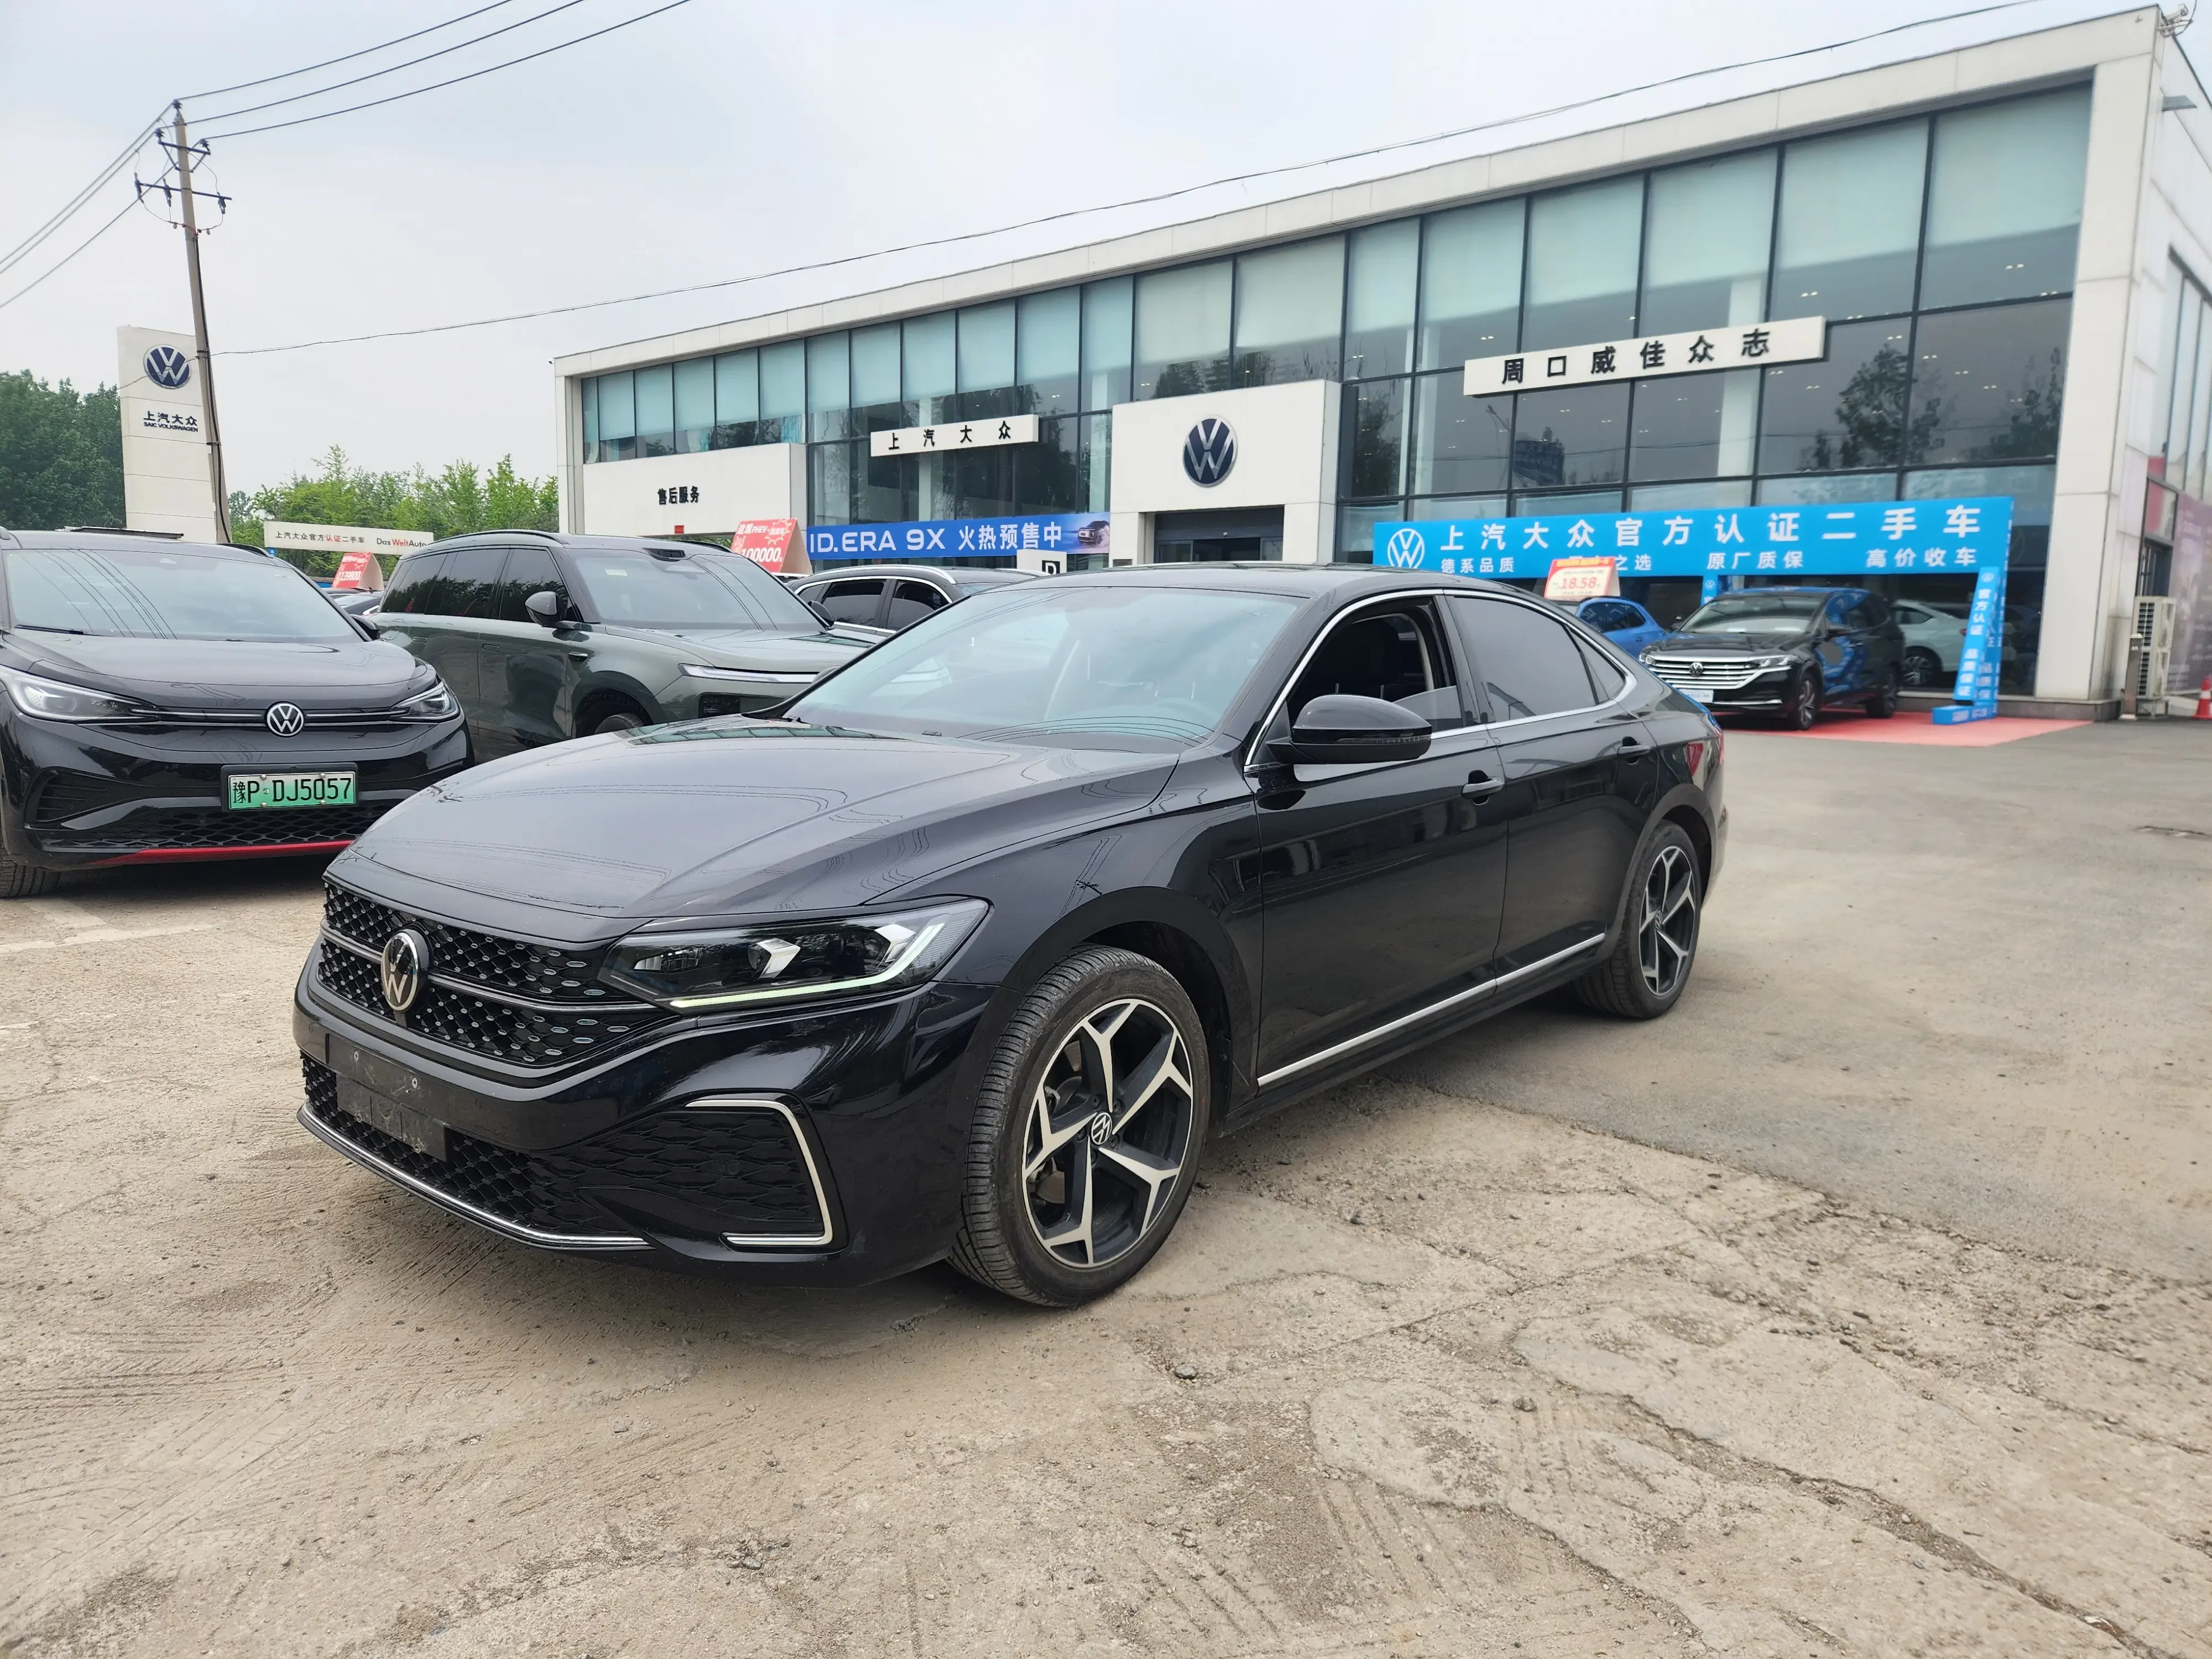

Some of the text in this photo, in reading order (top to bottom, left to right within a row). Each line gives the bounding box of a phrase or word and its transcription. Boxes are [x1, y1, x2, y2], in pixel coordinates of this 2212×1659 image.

[1501, 328, 1771, 385] 周口威佳众志
[143, 411, 197, 426] 上汽大众
[158, 423, 199, 432] VOLKSWAGEN
[888, 420, 1011, 450] 上汽大众
[657, 485, 700, 505] 售后服务
[275, 531, 365, 543] 上汽大众官方认证二手车
[810, 521, 1062, 553] ID.ERA 9X 火热预售中
[1440, 504, 1981, 551] 上汽大众官方认证二手车
[1441, 556, 1515, 573] 德系品质
[1706, 551, 1804, 570] 原厂质保
[1865, 547, 1977, 568] 高价收车
[1561, 576, 1597, 589] 18.58
